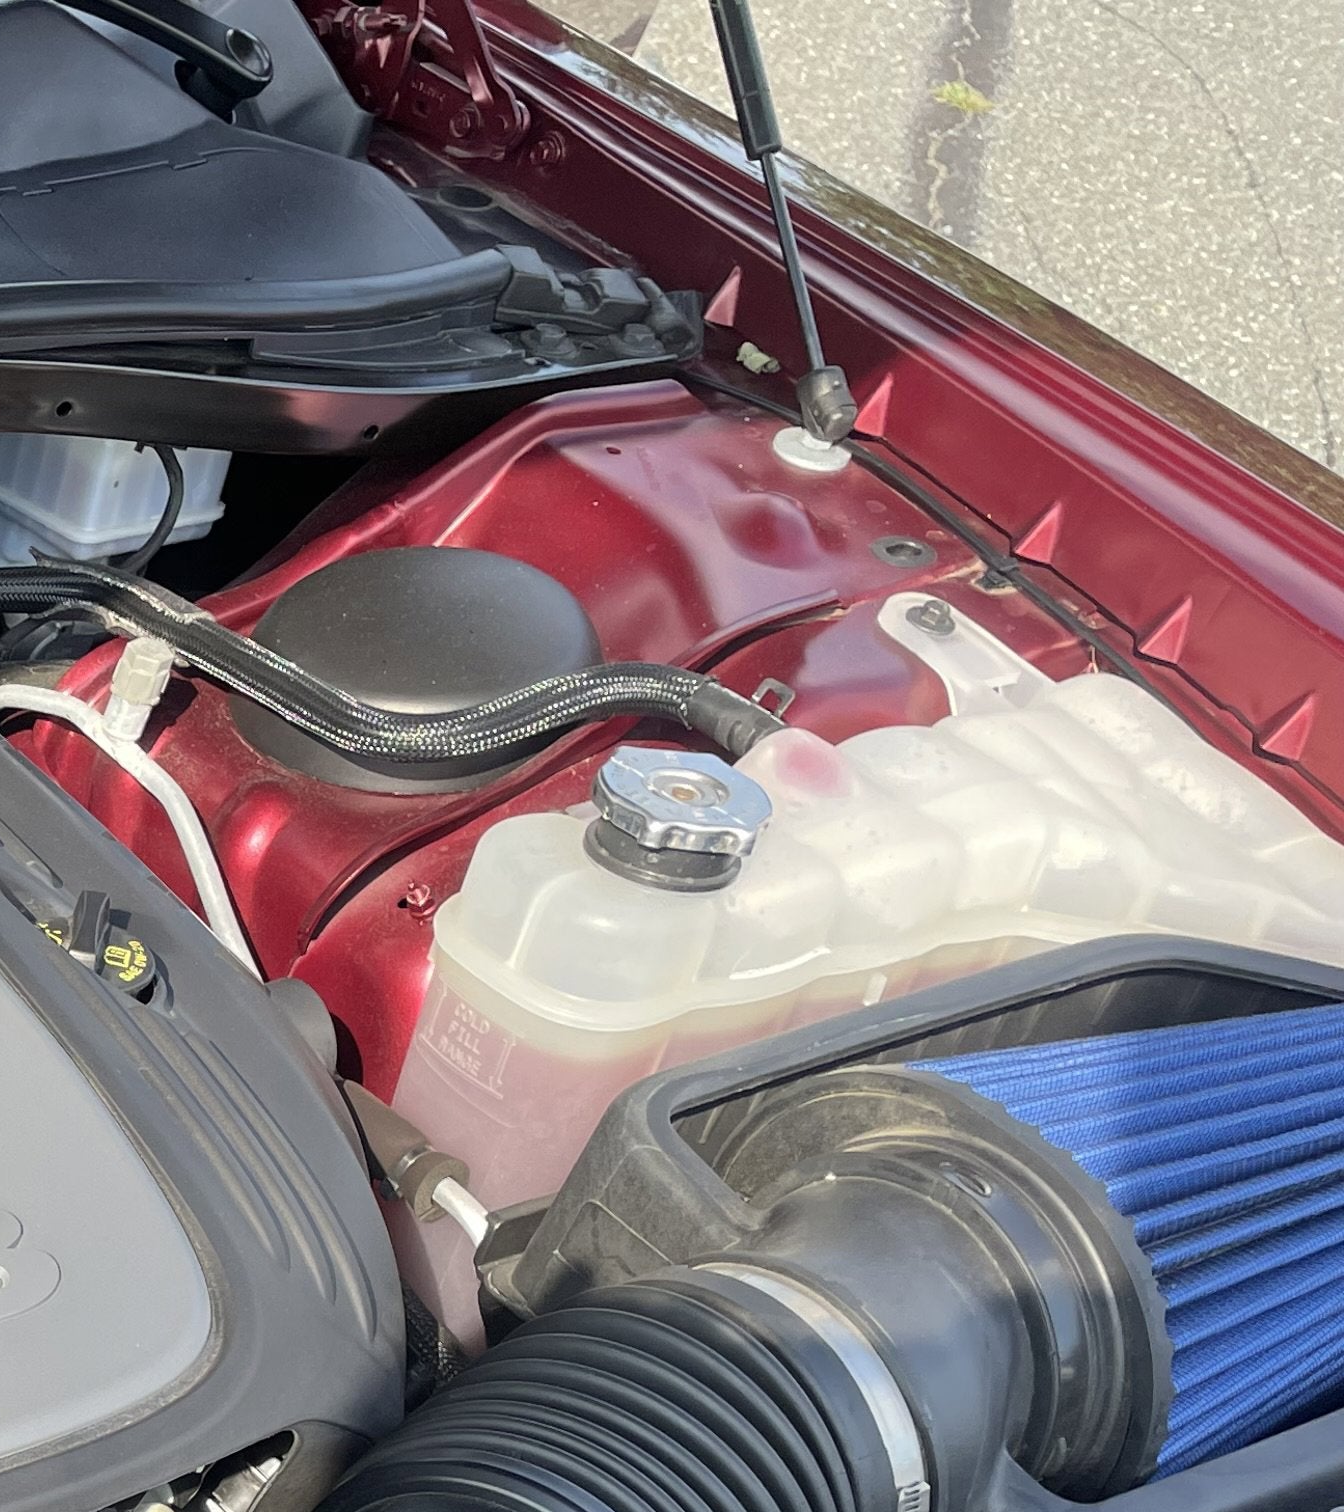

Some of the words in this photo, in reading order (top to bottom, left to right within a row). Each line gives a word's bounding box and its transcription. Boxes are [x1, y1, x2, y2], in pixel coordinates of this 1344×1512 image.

[454, 1003, 490, 1034] COLD
[438, 1034, 482, 1076] RANGE
[448, 1020, 480, 1055] FILL
